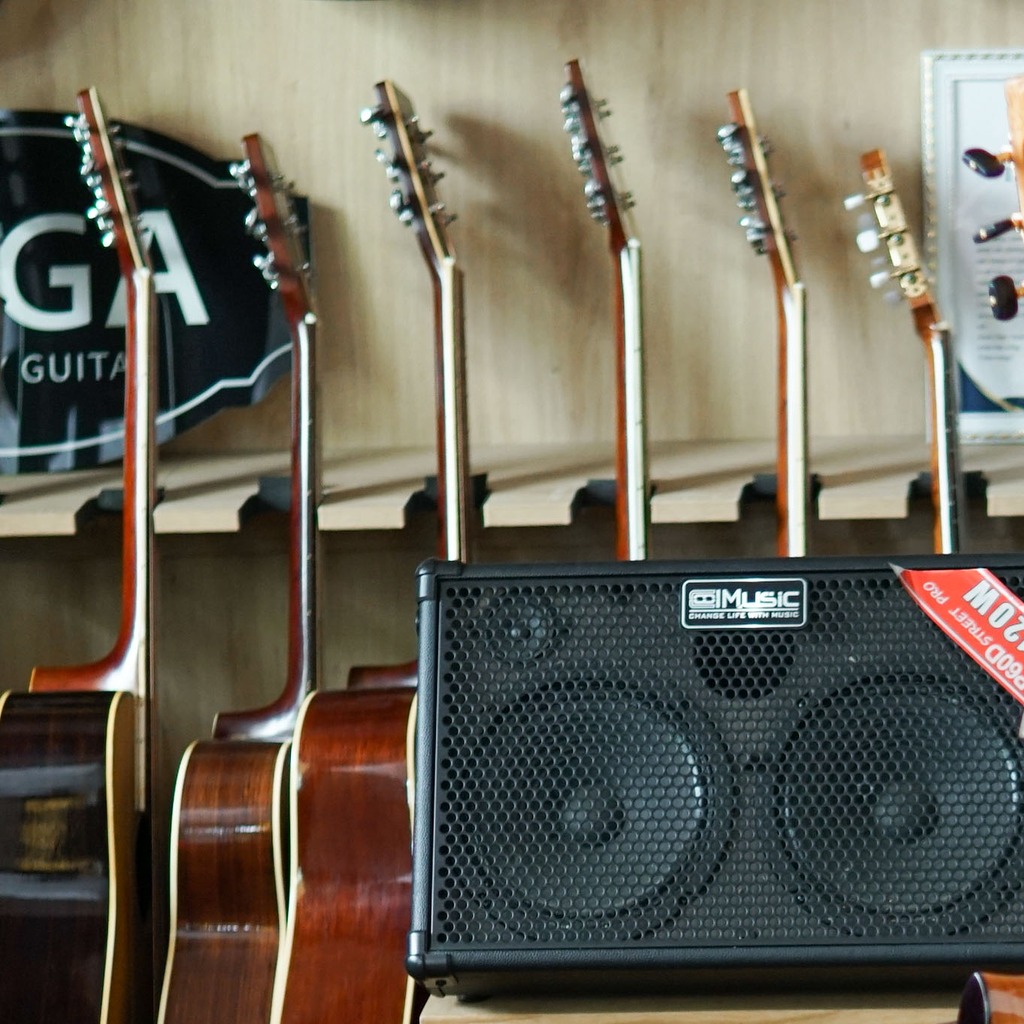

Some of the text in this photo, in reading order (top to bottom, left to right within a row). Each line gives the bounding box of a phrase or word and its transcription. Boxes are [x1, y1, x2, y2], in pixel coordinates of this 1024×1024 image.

[21, 352, 126, 384] GUITA
[922, 581, 949, 605] PRO
[771, 611, 800, 619] MUSIC
[948, 607, 993, 646] STREET
